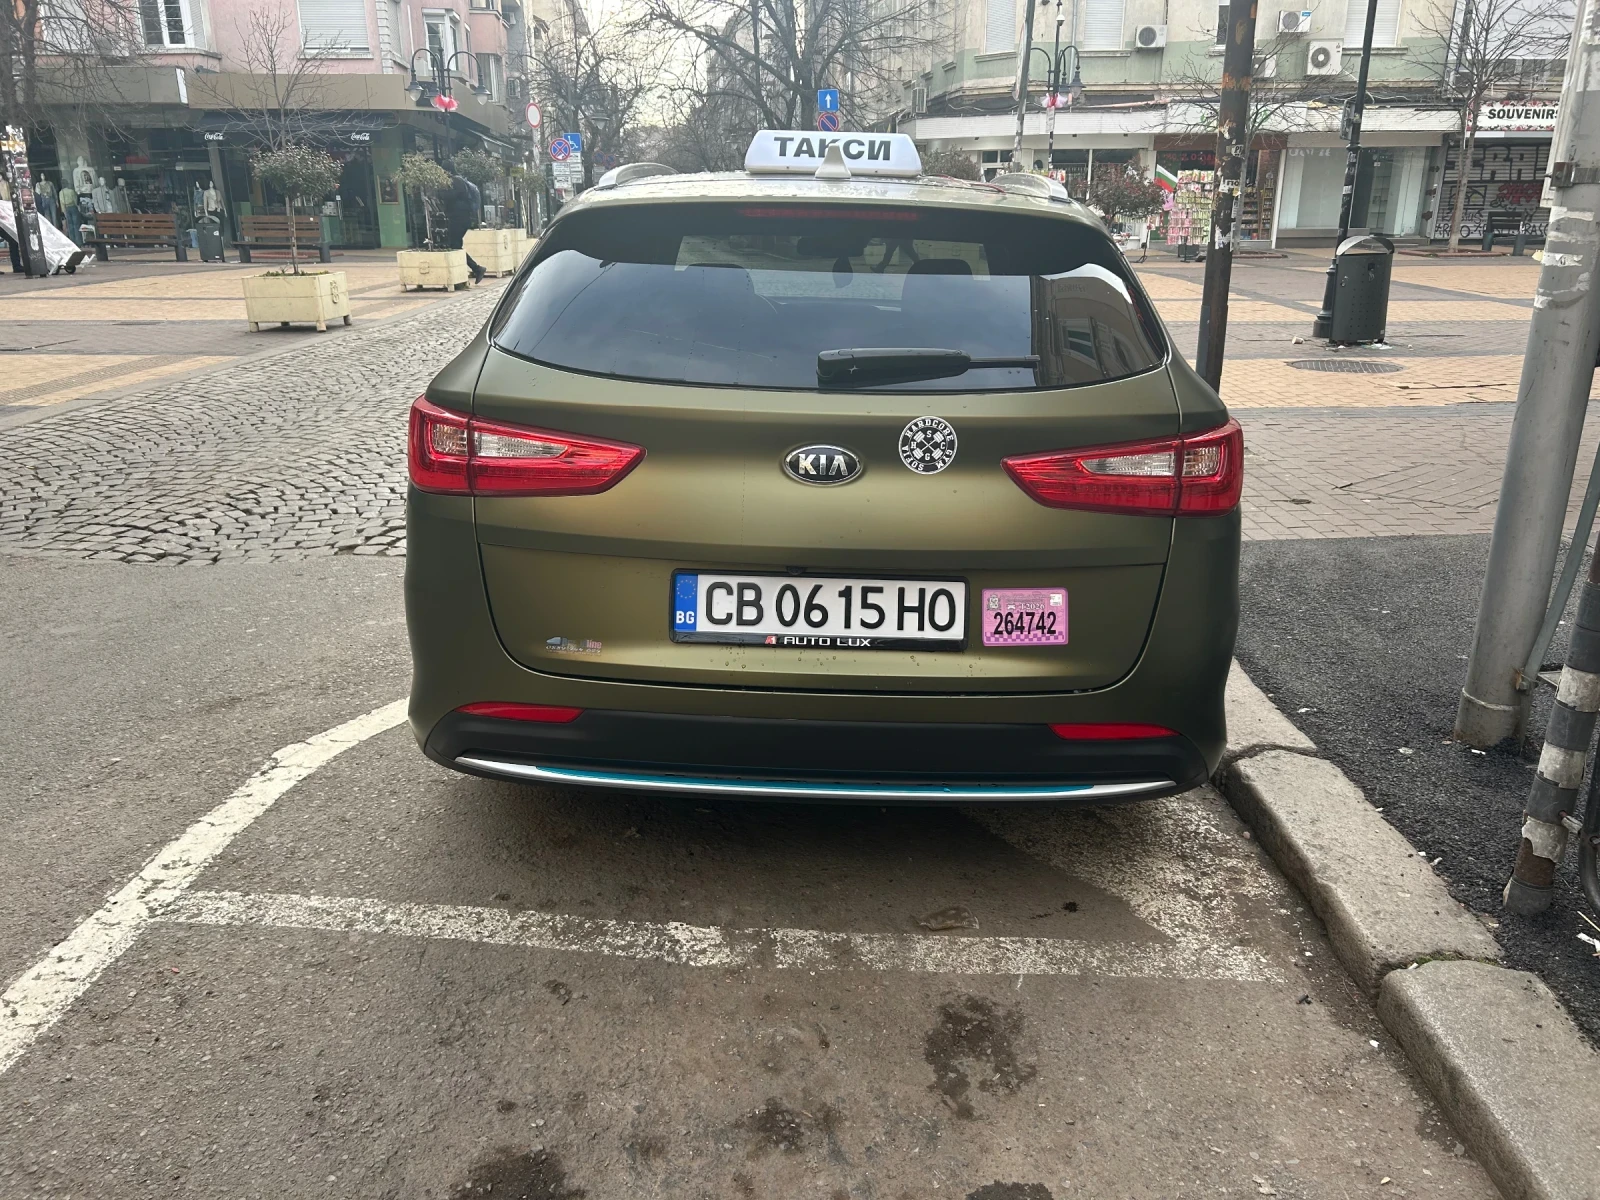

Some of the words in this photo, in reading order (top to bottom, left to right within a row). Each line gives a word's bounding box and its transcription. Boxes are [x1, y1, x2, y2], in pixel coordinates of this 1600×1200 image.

[774, 136, 891, 161] ТАКСИ
[905, 419, 954, 441] HARDCORE
[798, 453, 849, 476] KIA
[901, 445, 924, 471] SOFIA
[935, 449, 953, 469] GYM
[676, 610, 695, 624] BG
[775, 584, 886, 630] 0615
[993, 611, 1057, 635] 264742
[783, 636, 831, 646] AUTO
[836, 637, 871, 647] LUX
